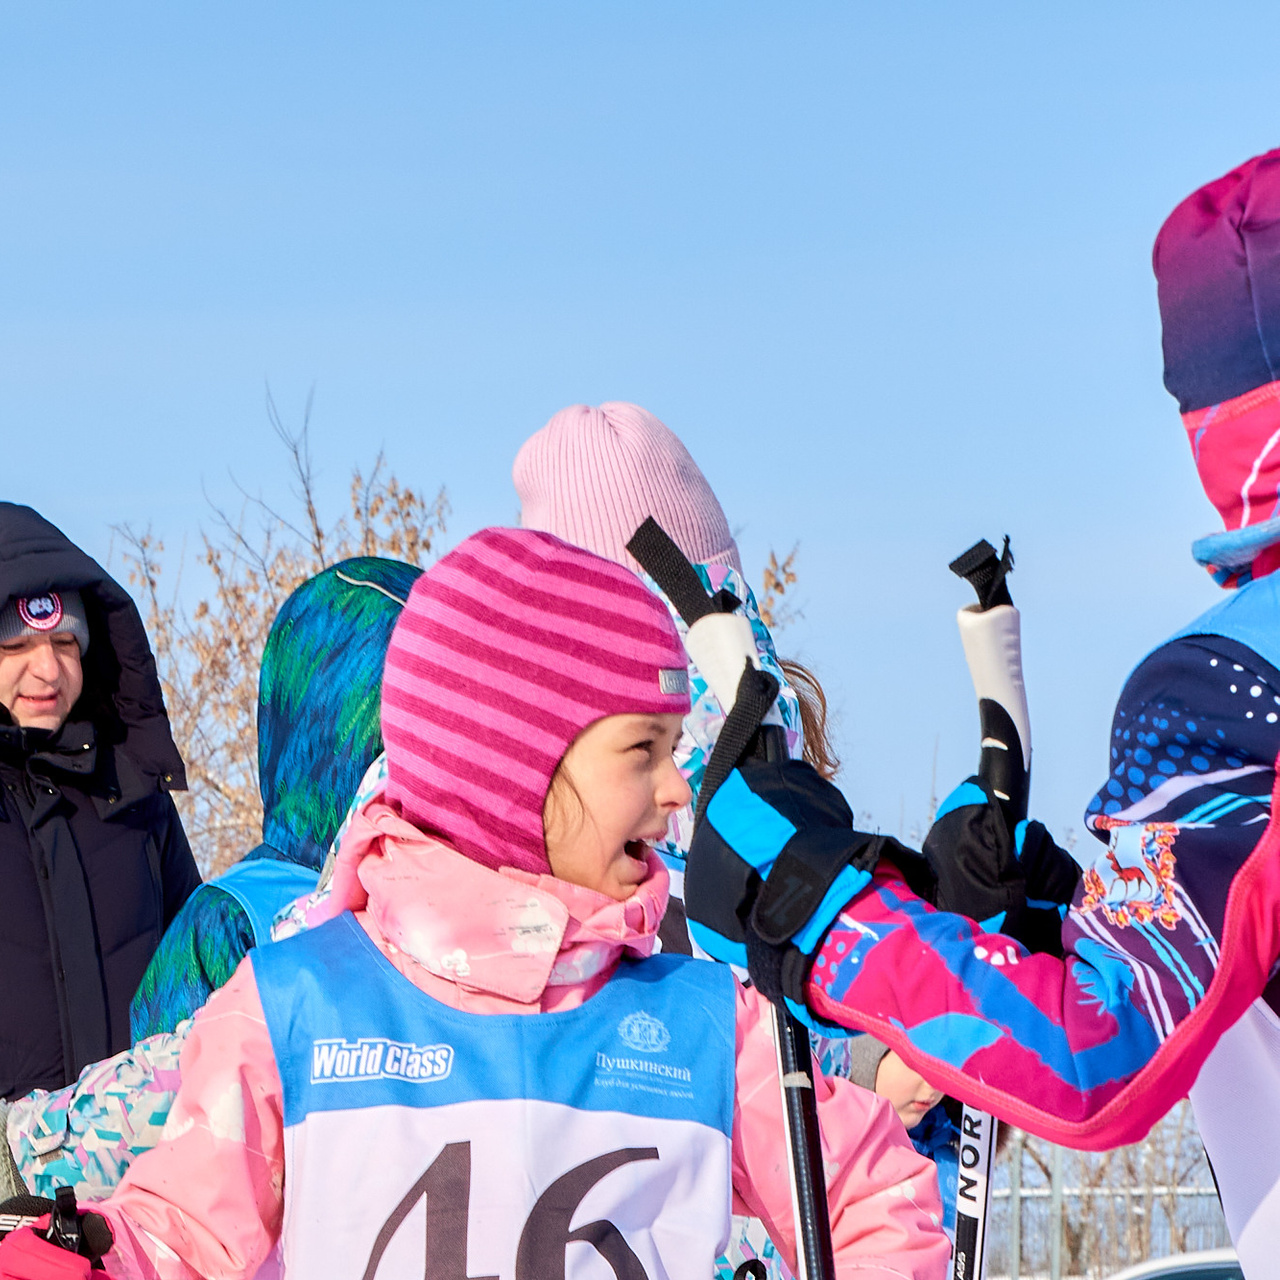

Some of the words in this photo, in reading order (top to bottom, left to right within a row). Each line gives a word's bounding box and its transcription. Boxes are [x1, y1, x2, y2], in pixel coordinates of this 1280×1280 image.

[313, 1043, 385, 1079] World
[385, 1045, 449, 1079] Class
[595, 1051, 691, 1083] Пушкинский
